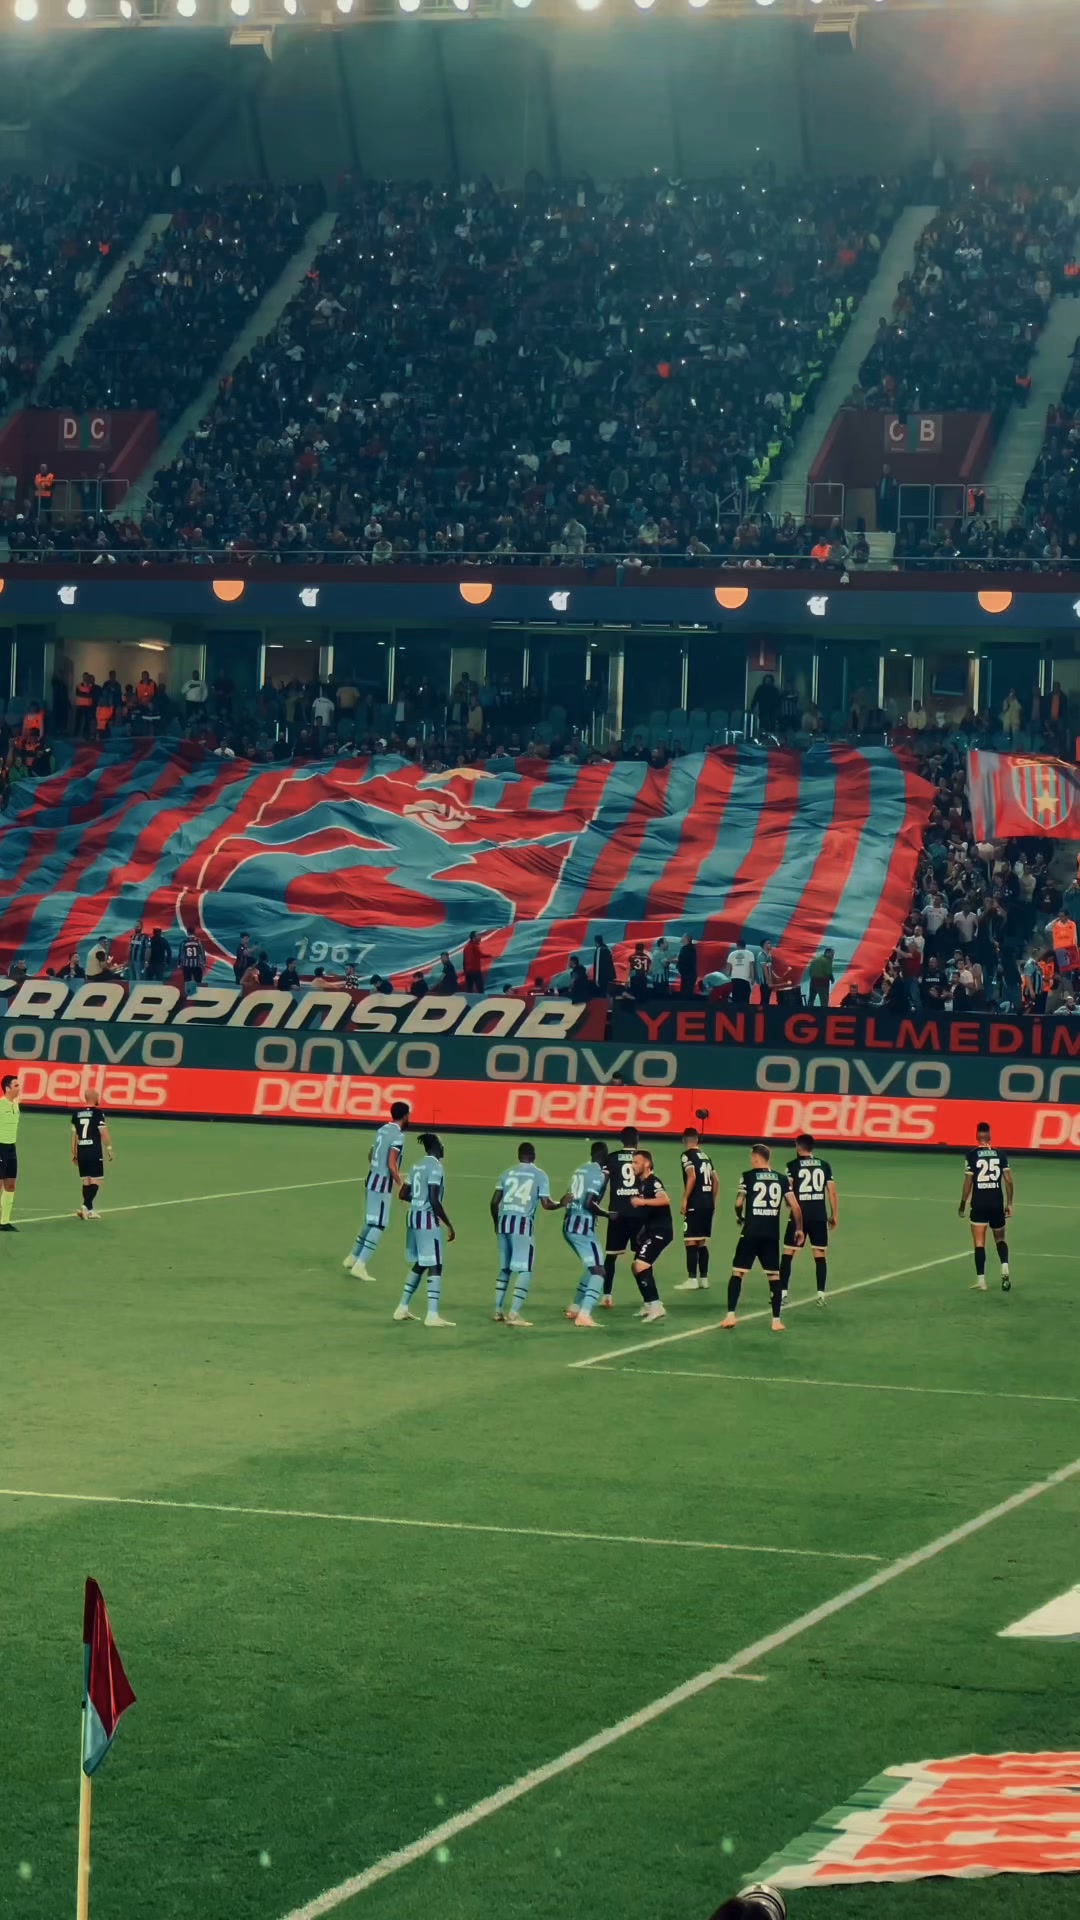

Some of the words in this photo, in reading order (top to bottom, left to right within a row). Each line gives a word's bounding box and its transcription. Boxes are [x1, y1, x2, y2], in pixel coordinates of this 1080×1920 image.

[64, 418, 77, 439] D
[91, 418, 104, 439] C
[920, 419, 935, 441] B
[294, 937, 376, 965] 1967
[634, 958, 648, 971] 31
[0, 979, 586, 1039] RABZONSPOR
[636, 1008, 765, 1043] YENİ
[3, 1025, 183, 1066] onvo
[254, 1036, 440, 1078] onvo
[486, 1044, 678, 1087] onvo
[756, 1055, 951, 1098] onvo
[504, 1085, 673, 1128] petlas
[763, 1094, 937, 1141] petlas
[79, 1118, 90, 1139] 7
[621, 1163, 636, 1187] 9
[798, 1168, 825, 1193] 20
[976, 1158, 1001, 1182] 25
[503, 1177, 534, 1205] 24
[752, 1181, 782, 1208] 29
